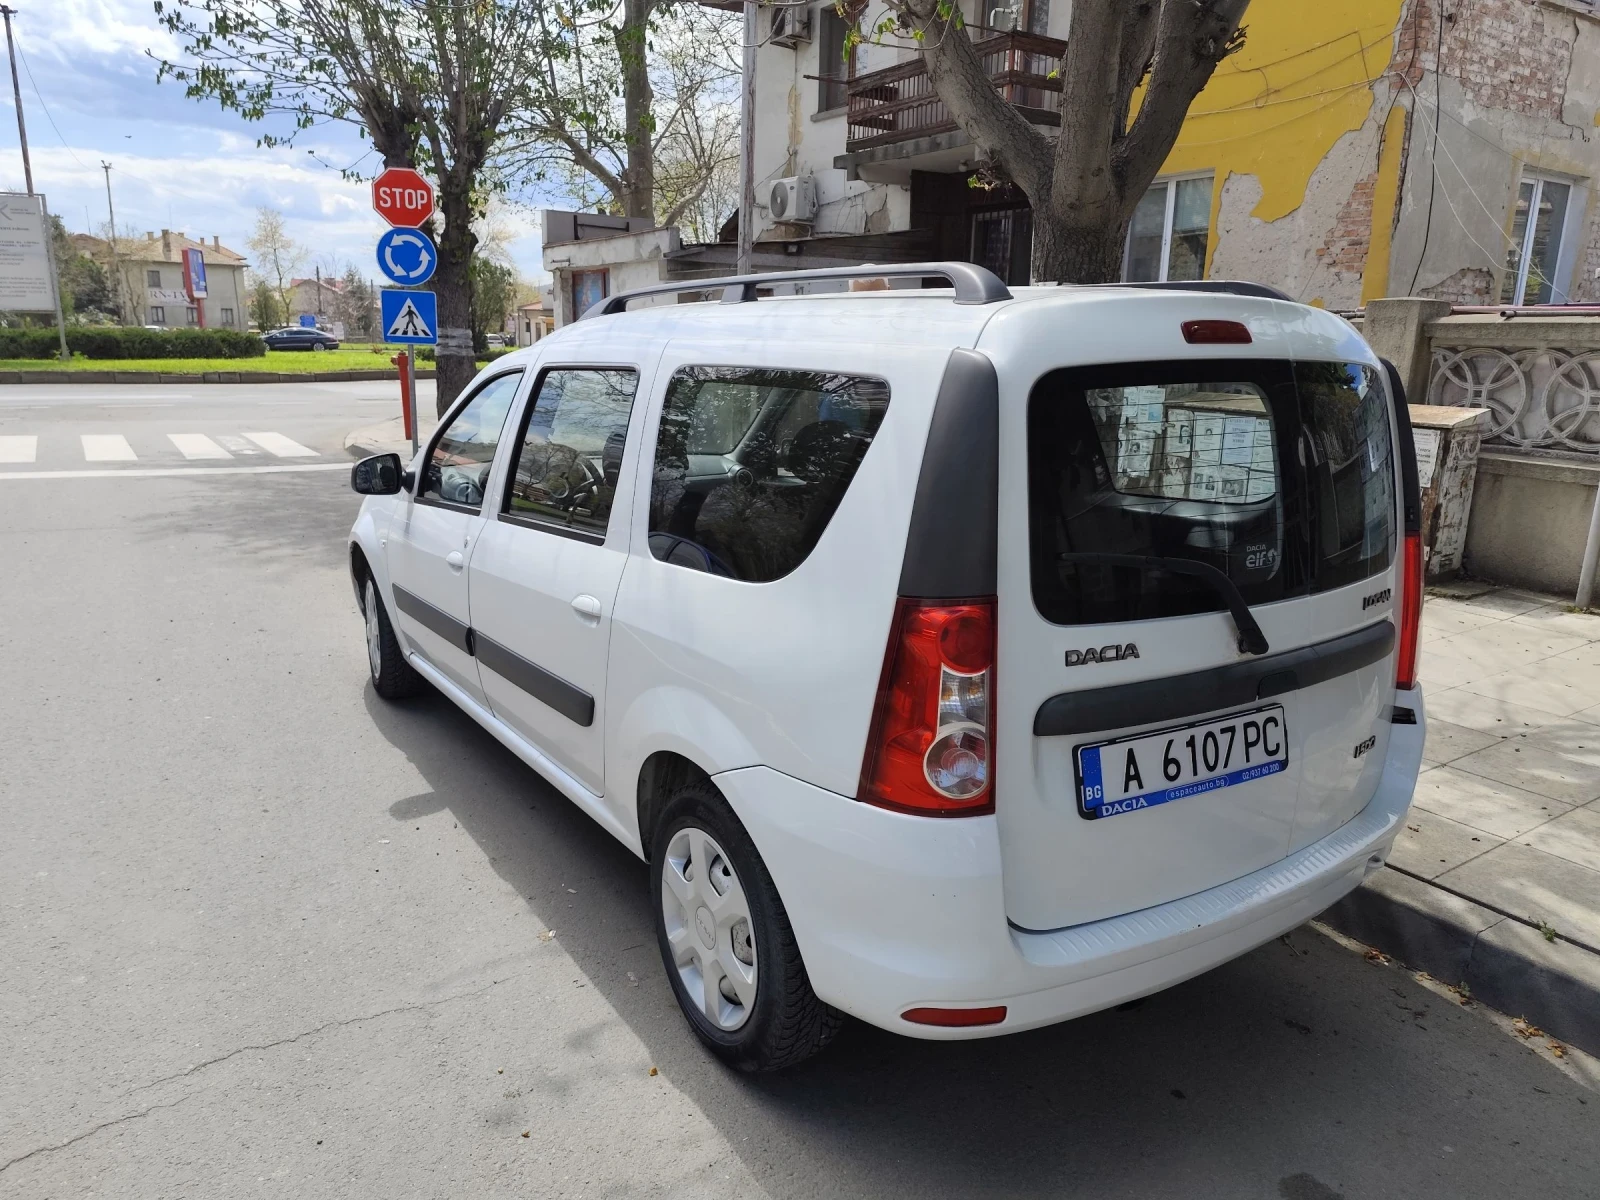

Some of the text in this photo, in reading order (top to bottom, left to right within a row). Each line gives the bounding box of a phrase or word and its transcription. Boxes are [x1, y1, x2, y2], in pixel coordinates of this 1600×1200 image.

[379, 187, 428, 210] STOP
[1246, 544, 1267, 552] DACIA
[1246, 551, 1267, 568] elf
[1362, 588, 1391, 610] LOGAN
[1065, 642, 1140, 667] DACIA
[1123, 716, 1280, 793] A 6107 PC
[1242, 763, 1279, 780] 02/937 60 200
[1085, 785, 1102, 801] BG
[1170, 779, 1225, 798] espaceauto.bg
[1101, 797, 1148, 816] DACIA
